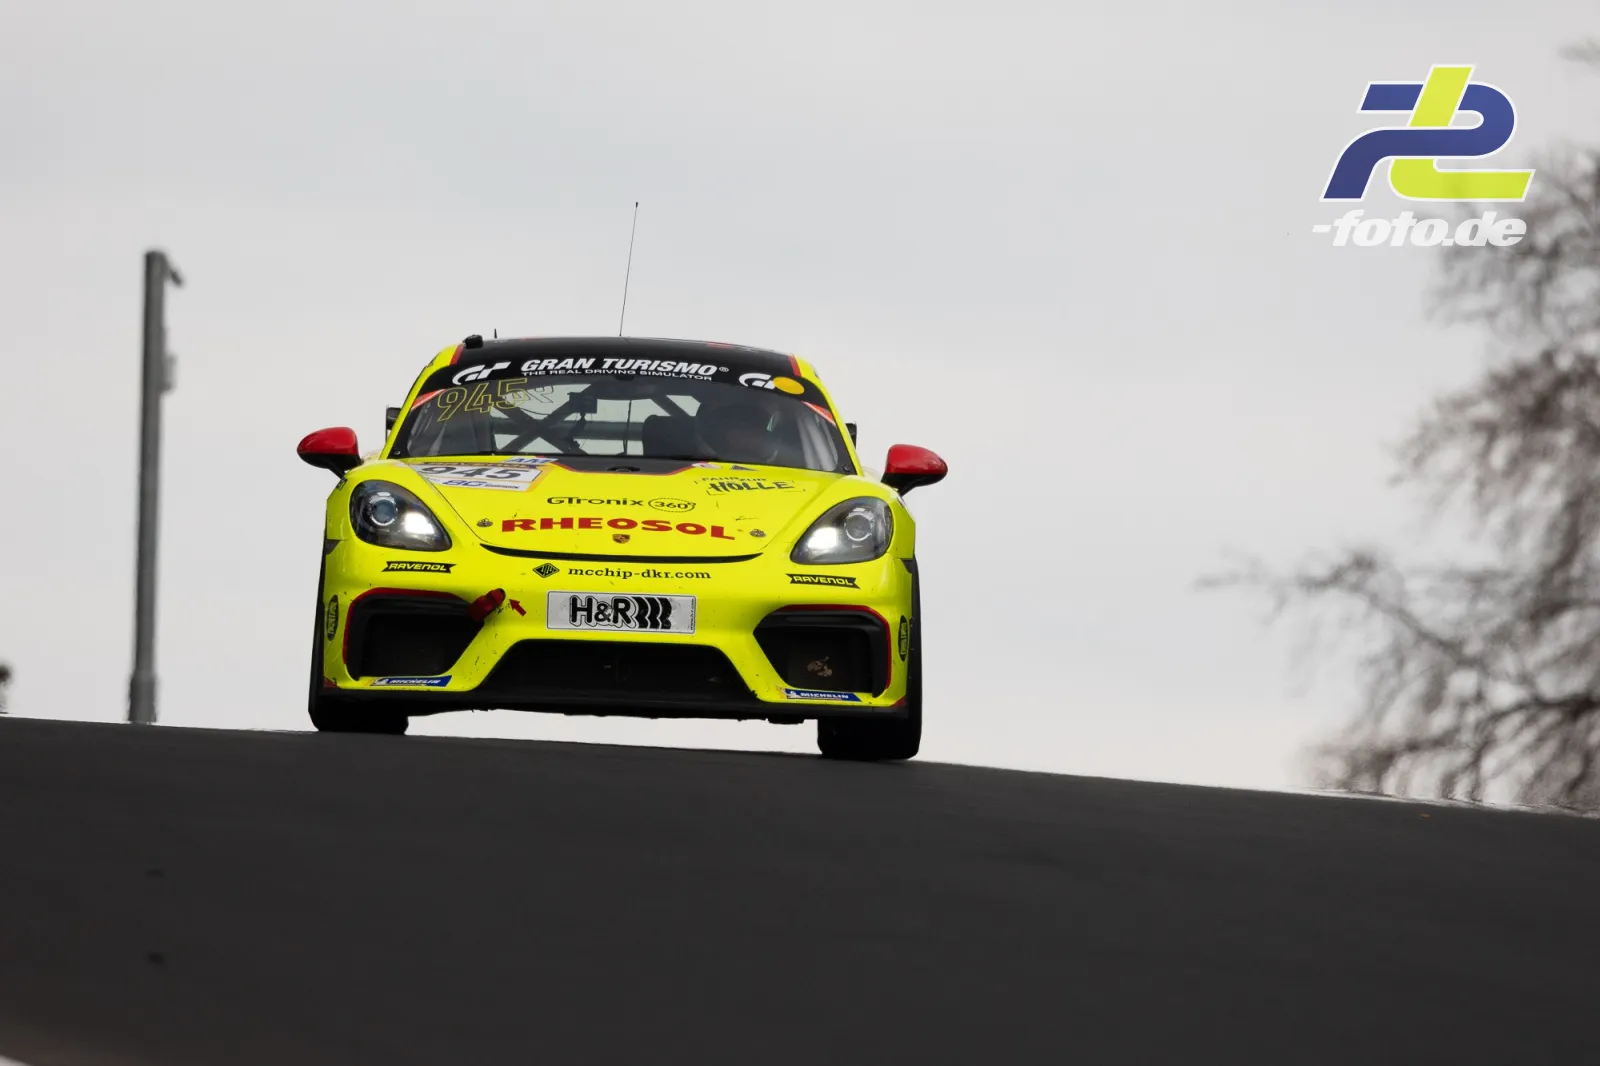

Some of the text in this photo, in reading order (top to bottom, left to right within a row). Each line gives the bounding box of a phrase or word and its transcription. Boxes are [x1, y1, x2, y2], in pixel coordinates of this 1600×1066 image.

[520, 357, 596, 372] GRAN
[585, 368, 636, 376] DRIVING
[639, 371, 712, 381] SIMULATOR
[437, 378, 528, 422] 945
[418, 466, 528, 480] 945
[501, 517, 736, 541] RHEOSOL
[388, 562, 448, 571] RAVENOL
[568, 566, 712, 580] mcchip-dkr.com
[793, 575, 855, 586] RAVENOL
[570, 595, 635, 627] H&R
